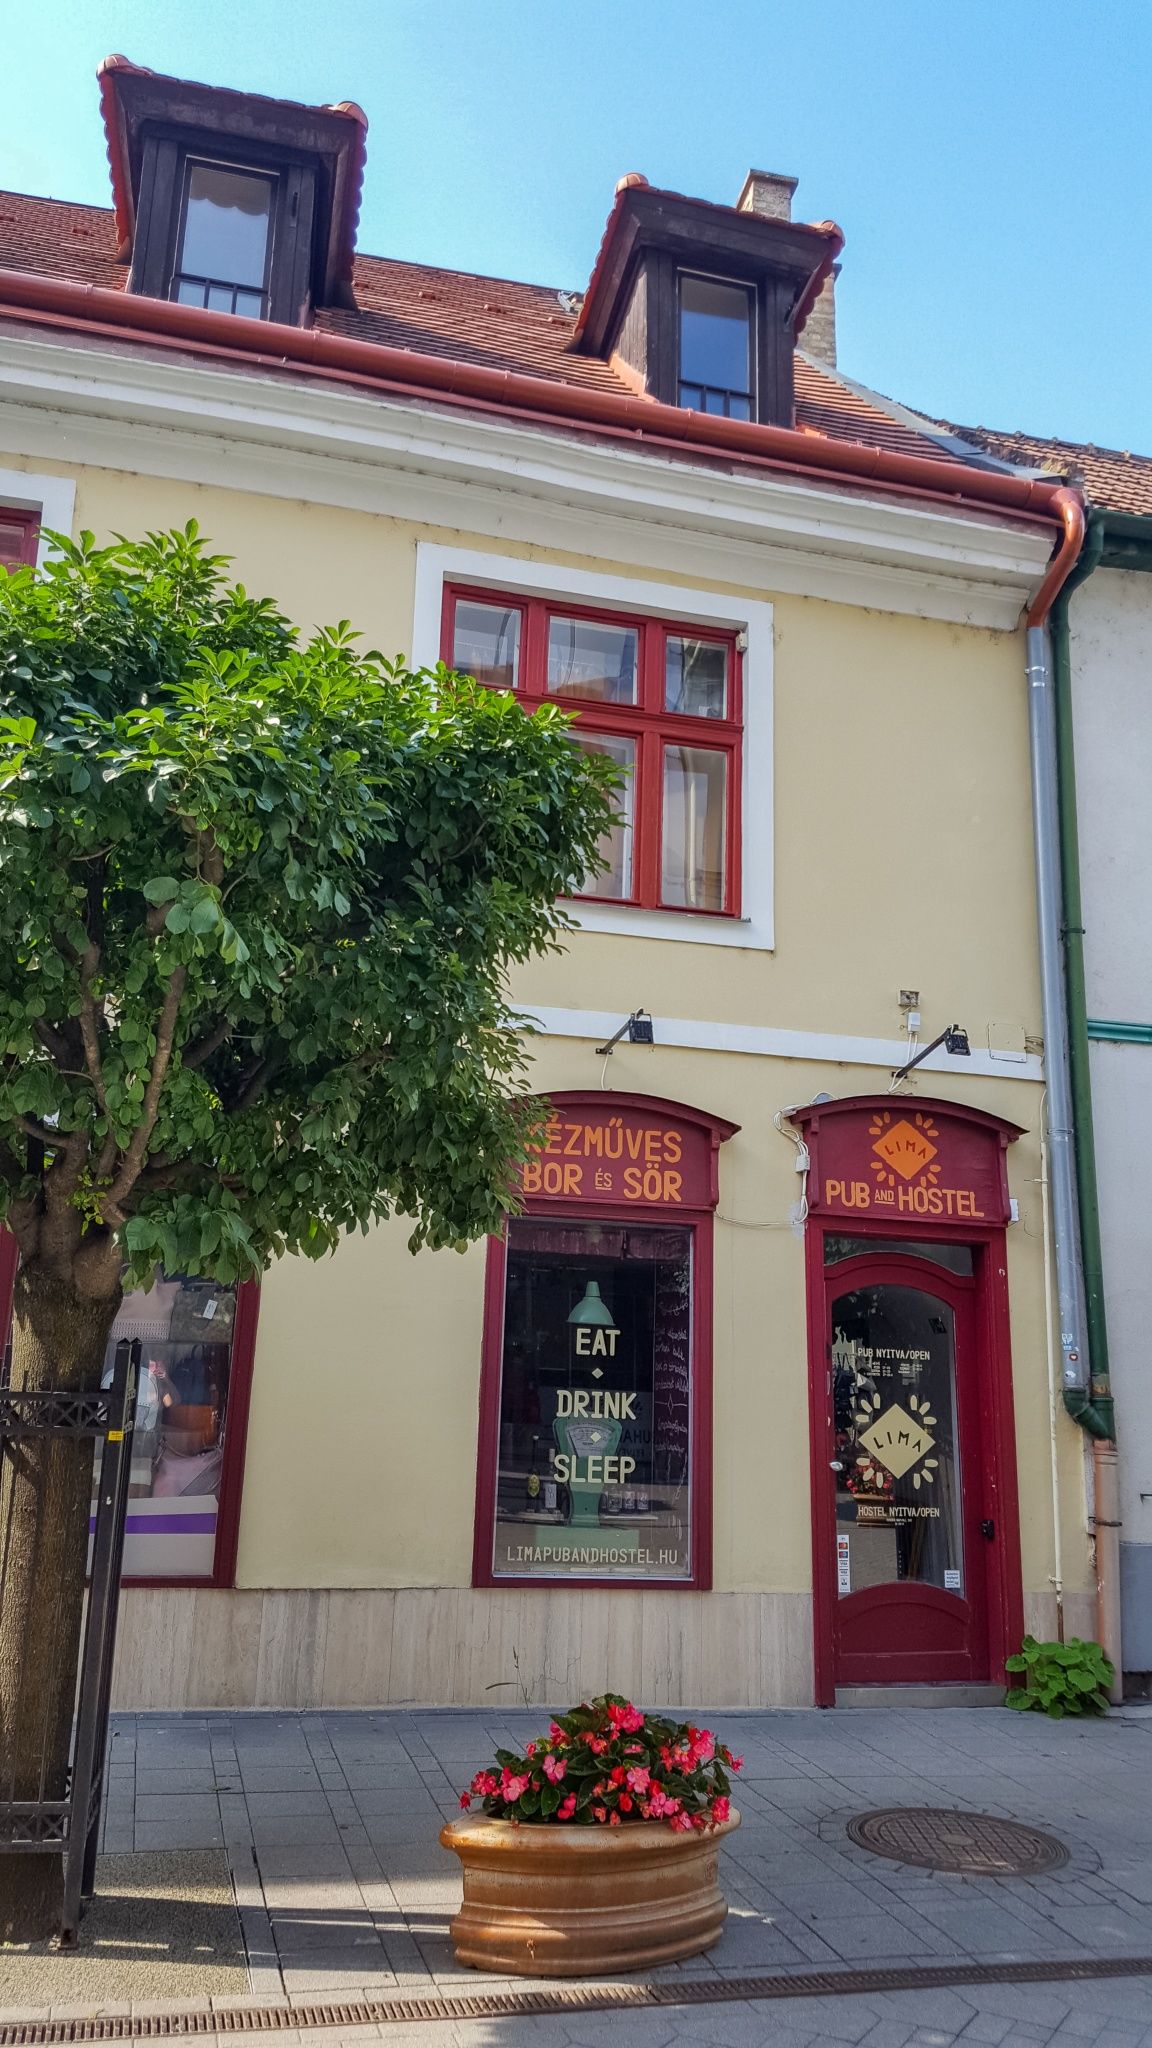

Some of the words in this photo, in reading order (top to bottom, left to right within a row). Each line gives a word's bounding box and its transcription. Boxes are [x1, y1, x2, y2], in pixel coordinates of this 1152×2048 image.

[884, 1140, 927, 1160] LIMA
[523, 1161, 582, 1196] BOR
[595, 1168, 613, 1190] ÉS
[623, 1162, 683, 1202] SÖR
[826, 1179, 870, 1208] PUB
[874, 1188, 895, 1203] AND
[898, 1185, 985, 1218] HOSTEL
[575, 1328, 621, 1357] EAT
[857, 1347, 874, 1358] PUB
[876, 1348, 931, 1361] NYITVA/OPEN
[556, 1389, 637, 1420] DRINK
[873, 1430, 922, 1453] LIMA
[553, 1454, 636, 1485] SLEEP
[857, 1505, 887, 1517] HOSTEL
[889, 1506, 940, 1518] NYITVA/OPEN
[507, 1546, 678, 1565] LIMAPUBANDHOSTEL.HU
